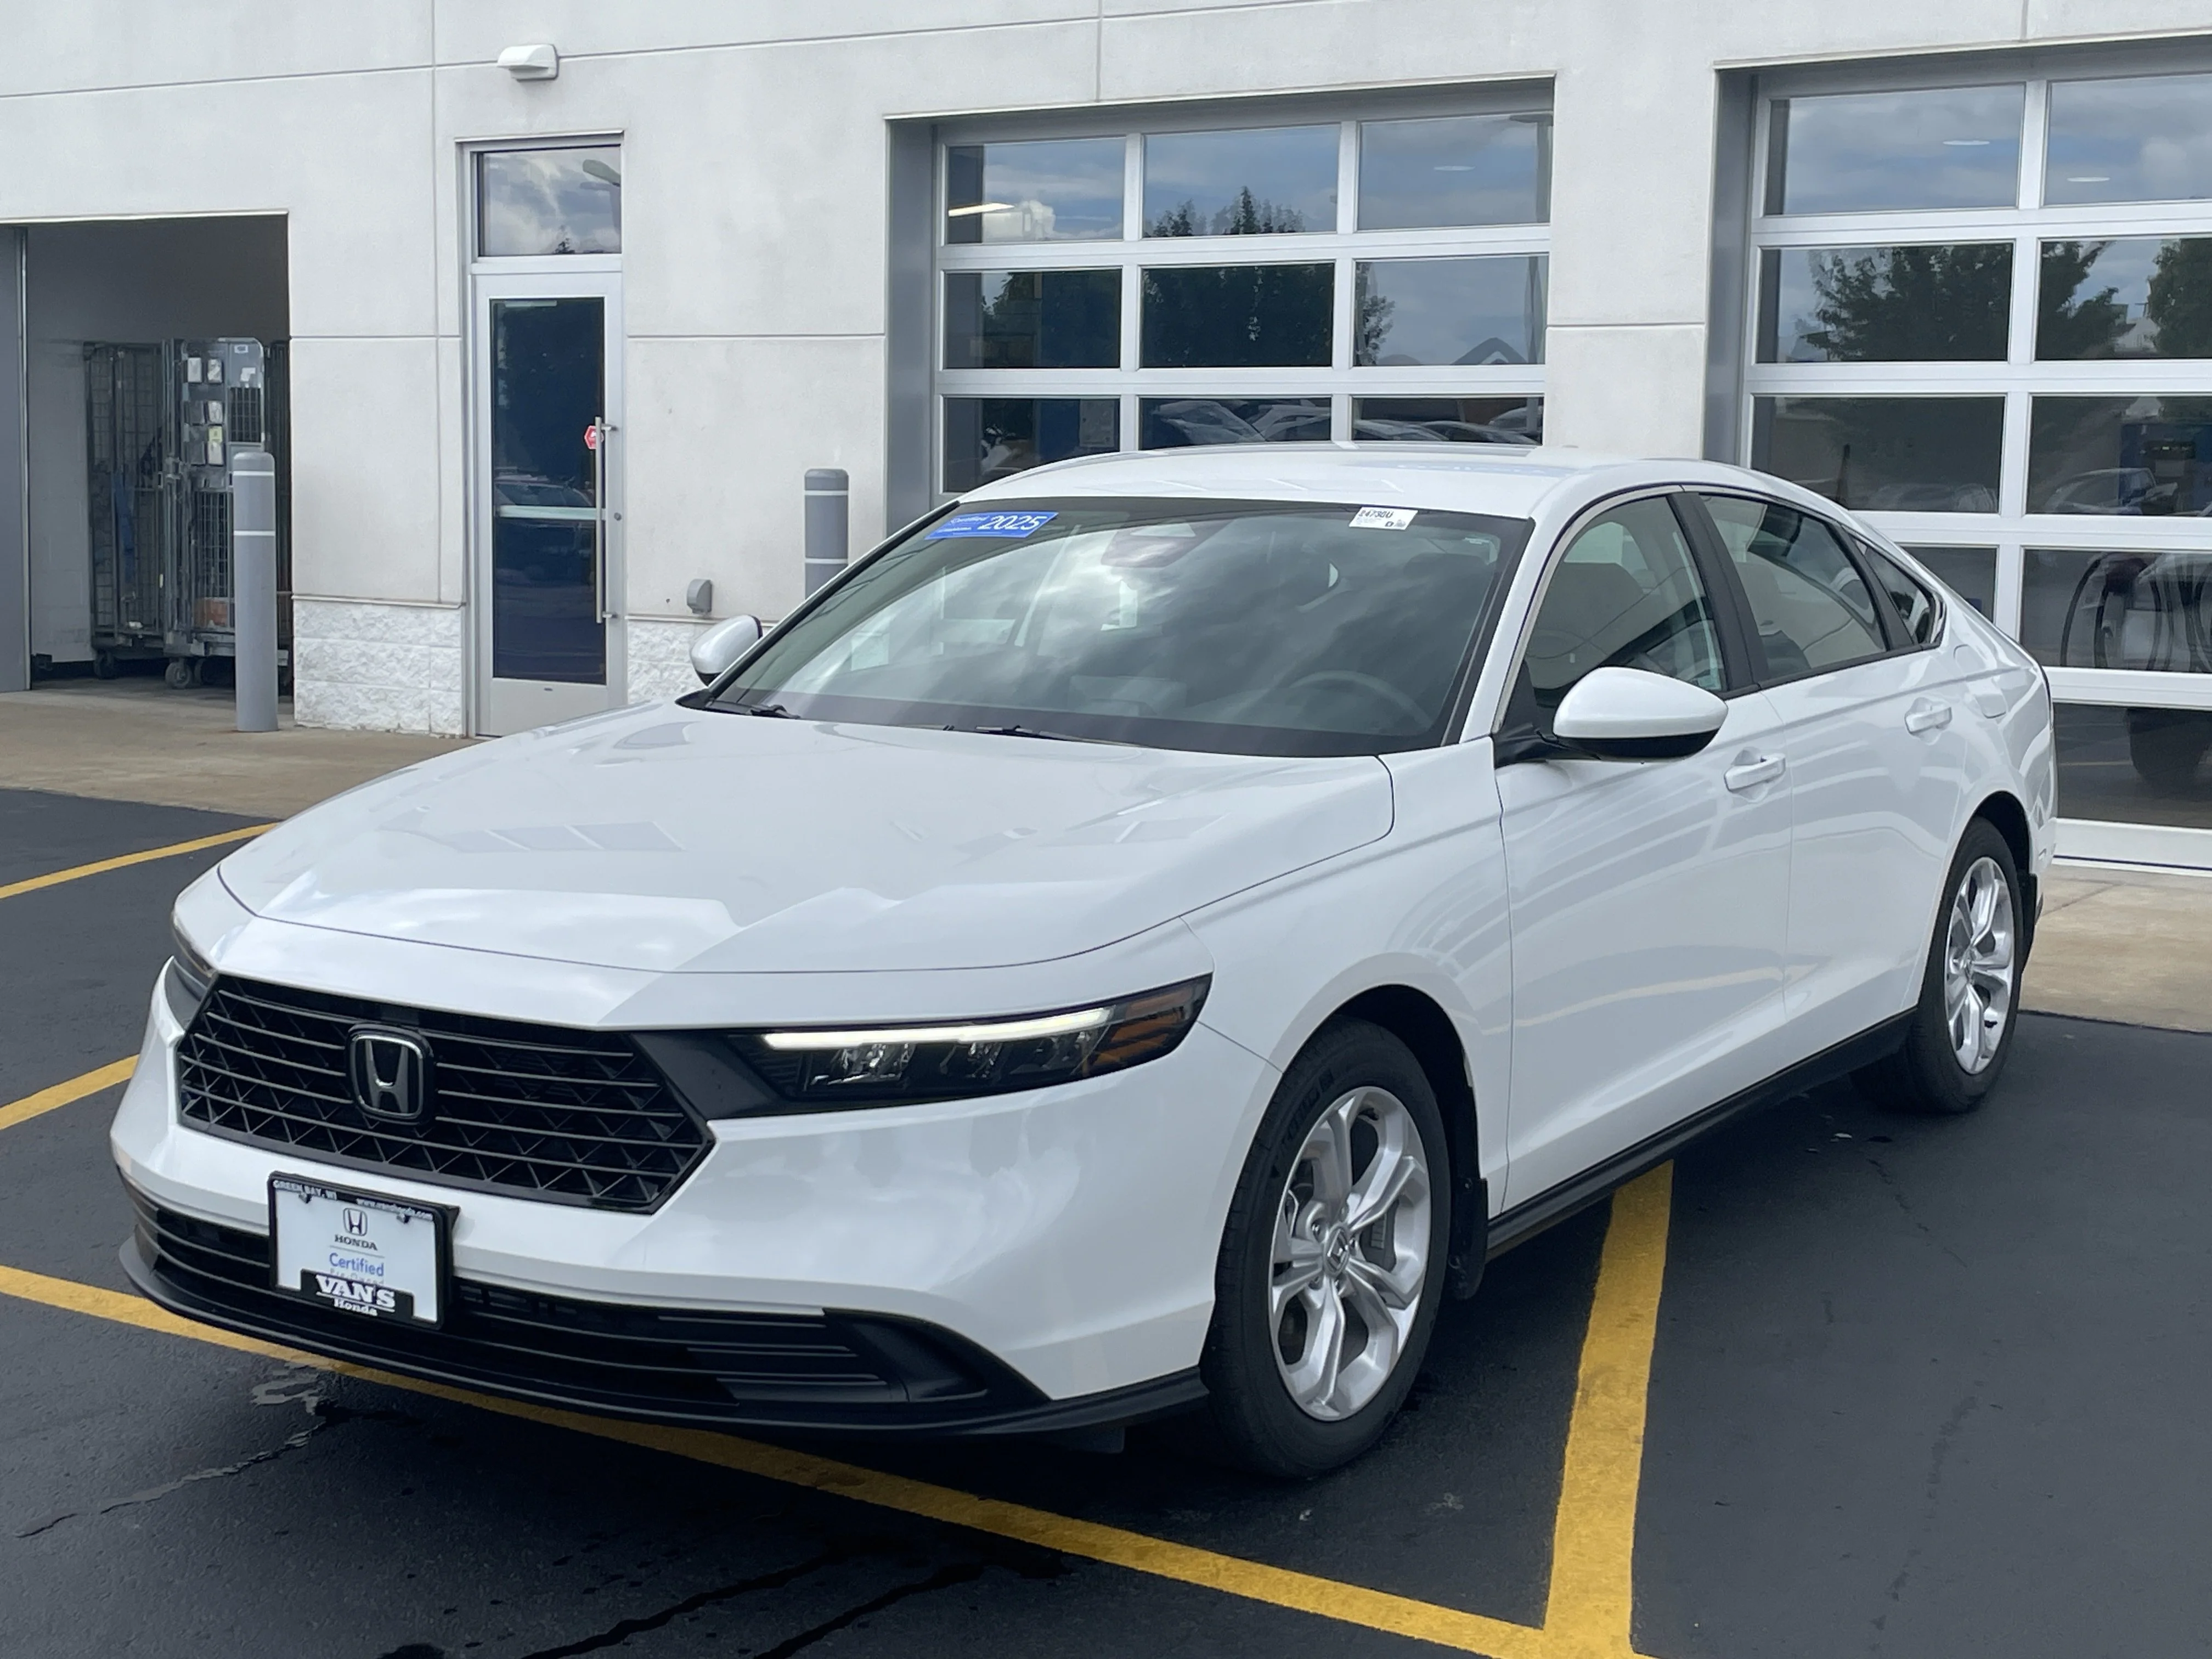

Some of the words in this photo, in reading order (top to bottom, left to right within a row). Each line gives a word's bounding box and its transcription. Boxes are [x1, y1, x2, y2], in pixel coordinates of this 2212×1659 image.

[977, 515, 1048, 531] 2025
[335, 1234, 377, 1251] HONDA
[329, 1252, 385, 1277] Certified
[315, 1274, 396, 1308] VAN'S
[334, 1297, 378, 1317] Honda
